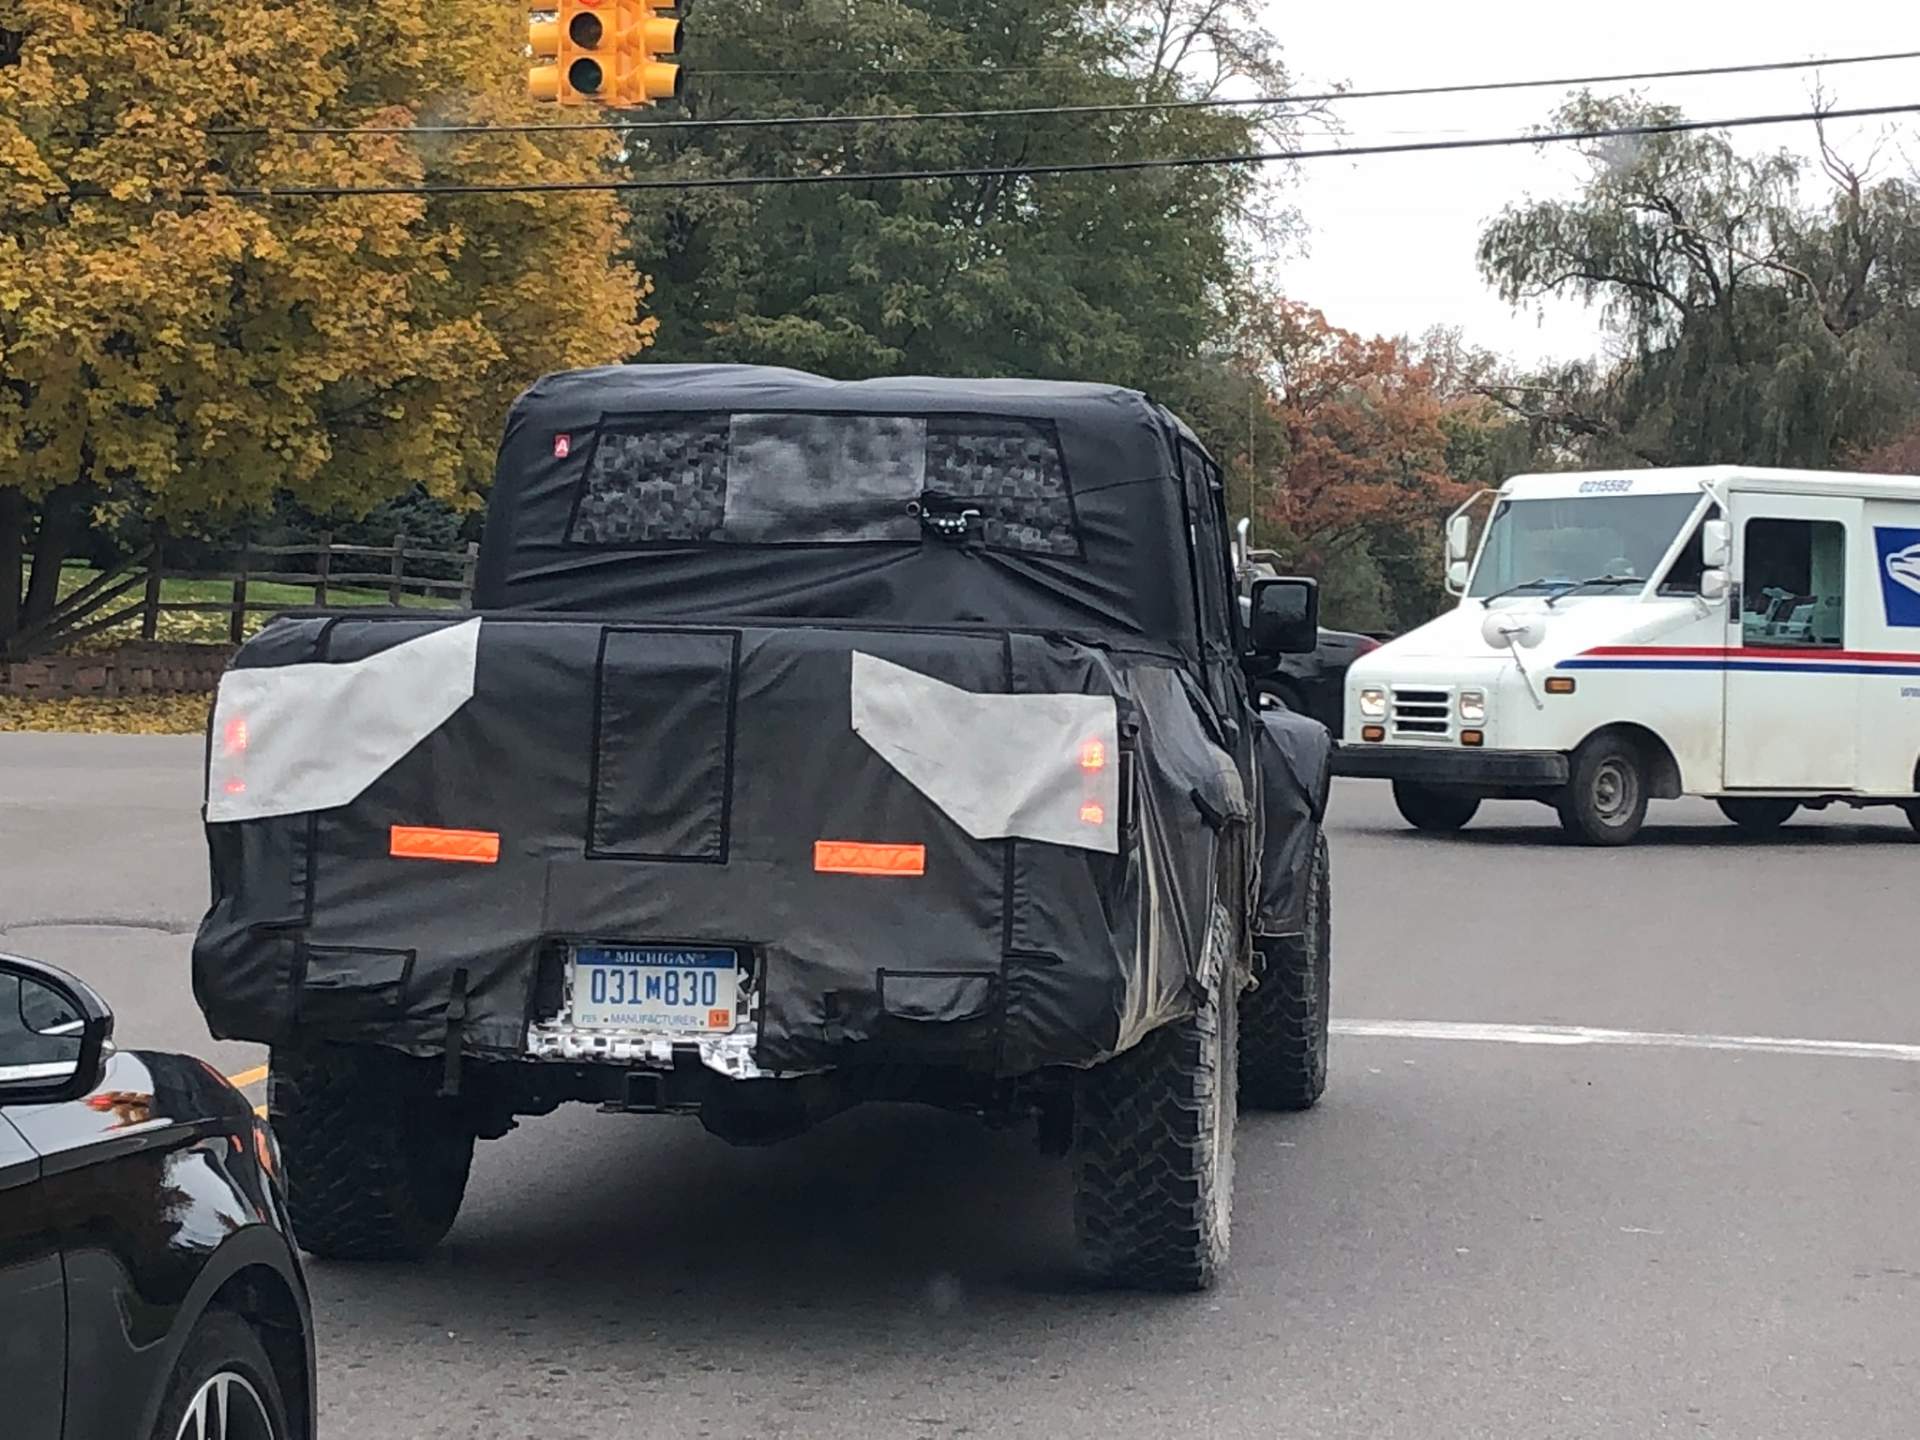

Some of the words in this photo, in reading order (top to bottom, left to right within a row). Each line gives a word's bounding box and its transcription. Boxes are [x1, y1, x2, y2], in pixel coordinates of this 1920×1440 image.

[616, 951, 695, 964] MICHIGAN
[591, 969, 717, 1006] 031M830
[609, 1014, 697, 1026] MANUFACTURER
